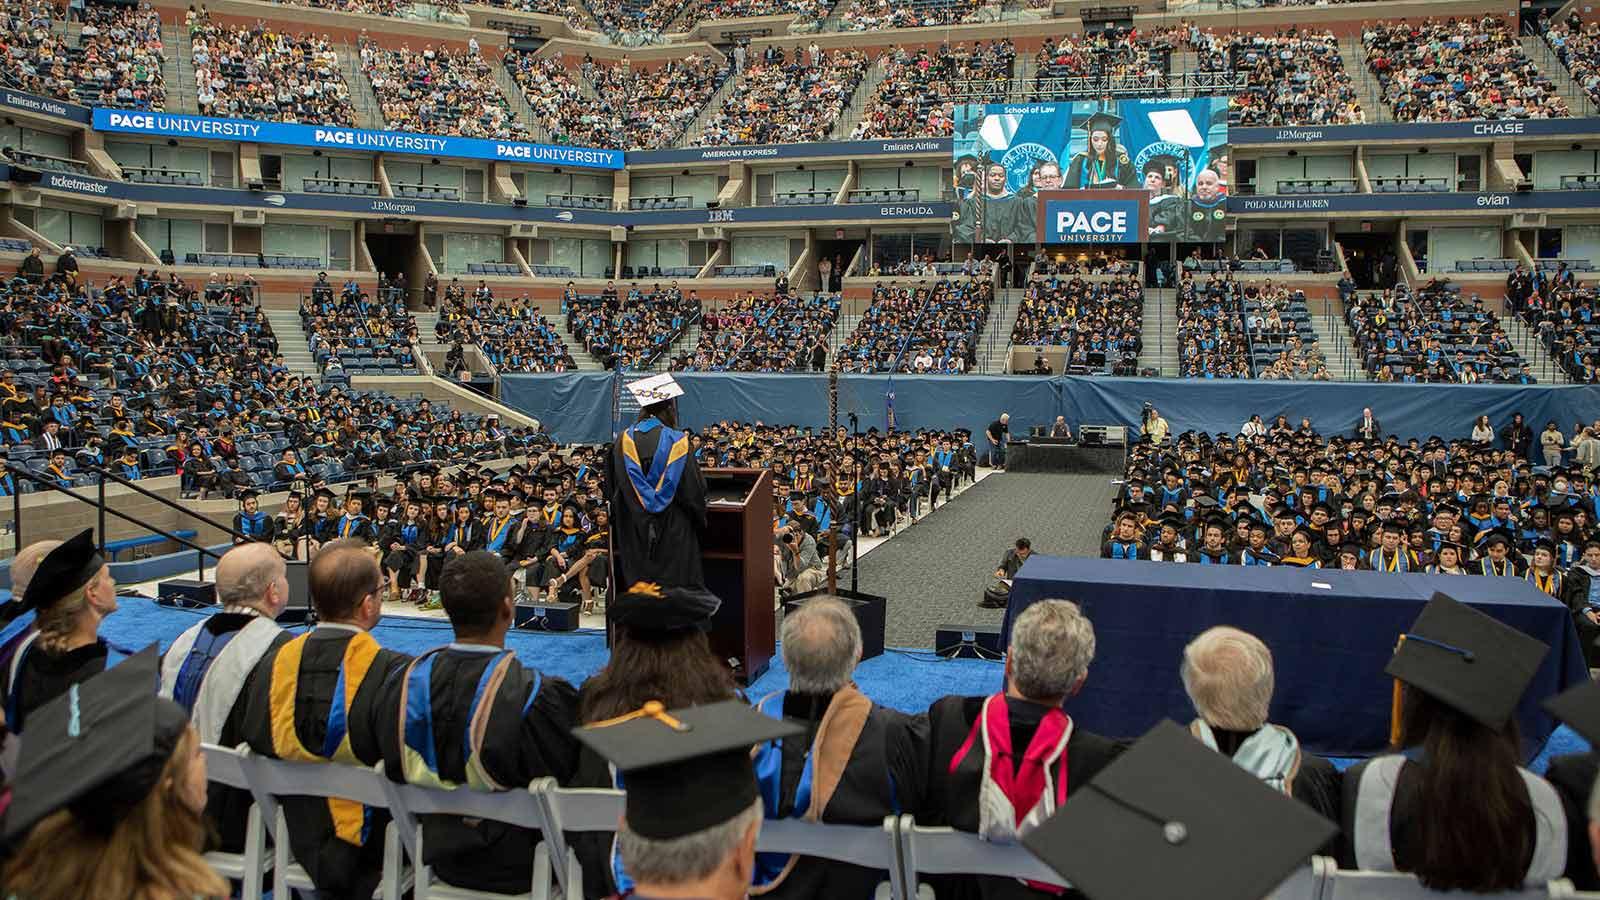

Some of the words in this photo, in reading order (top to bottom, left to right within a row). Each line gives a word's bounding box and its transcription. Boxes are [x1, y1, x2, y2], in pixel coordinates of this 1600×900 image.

[6, 93, 41, 109] Emirates
[41, 99, 67, 116] Airline
[1004, 106, 1029, 114] School
[110, 113, 155, 129] PACE
[158, 116, 261, 137] UNIVERSITY
[1473, 123, 1524, 135] CHASE
[315, 129, 354, 145] PACE
[356, 133, 448, 151] UNIVERSITY
[883, 142, 914, 152] Emirates
[915, 141, 940, 150] Airline
[497, 145, 531, 158] PACE
[533, 148, 614, 165] UNIVERSITY
[701, 149, 742, 159] AMERICAN
[742, 148, 778, 157] EXPRESS
[51, 175, 108, 194] ticketmaster
[1244, 200, 1267, 209] POLO
[1268, 200, 1295, 209] RALPH
[1296, 199, 1330, 209] LAUREN
[1475, 194, 1510, 207] evian
[708, 210, 735, 222] IBM
[880, 207, 934, 216] BERMUDA
[1056, 211, 1127, 233] PACE
[1060, 234, 1124, 242] UNIVERSITY
